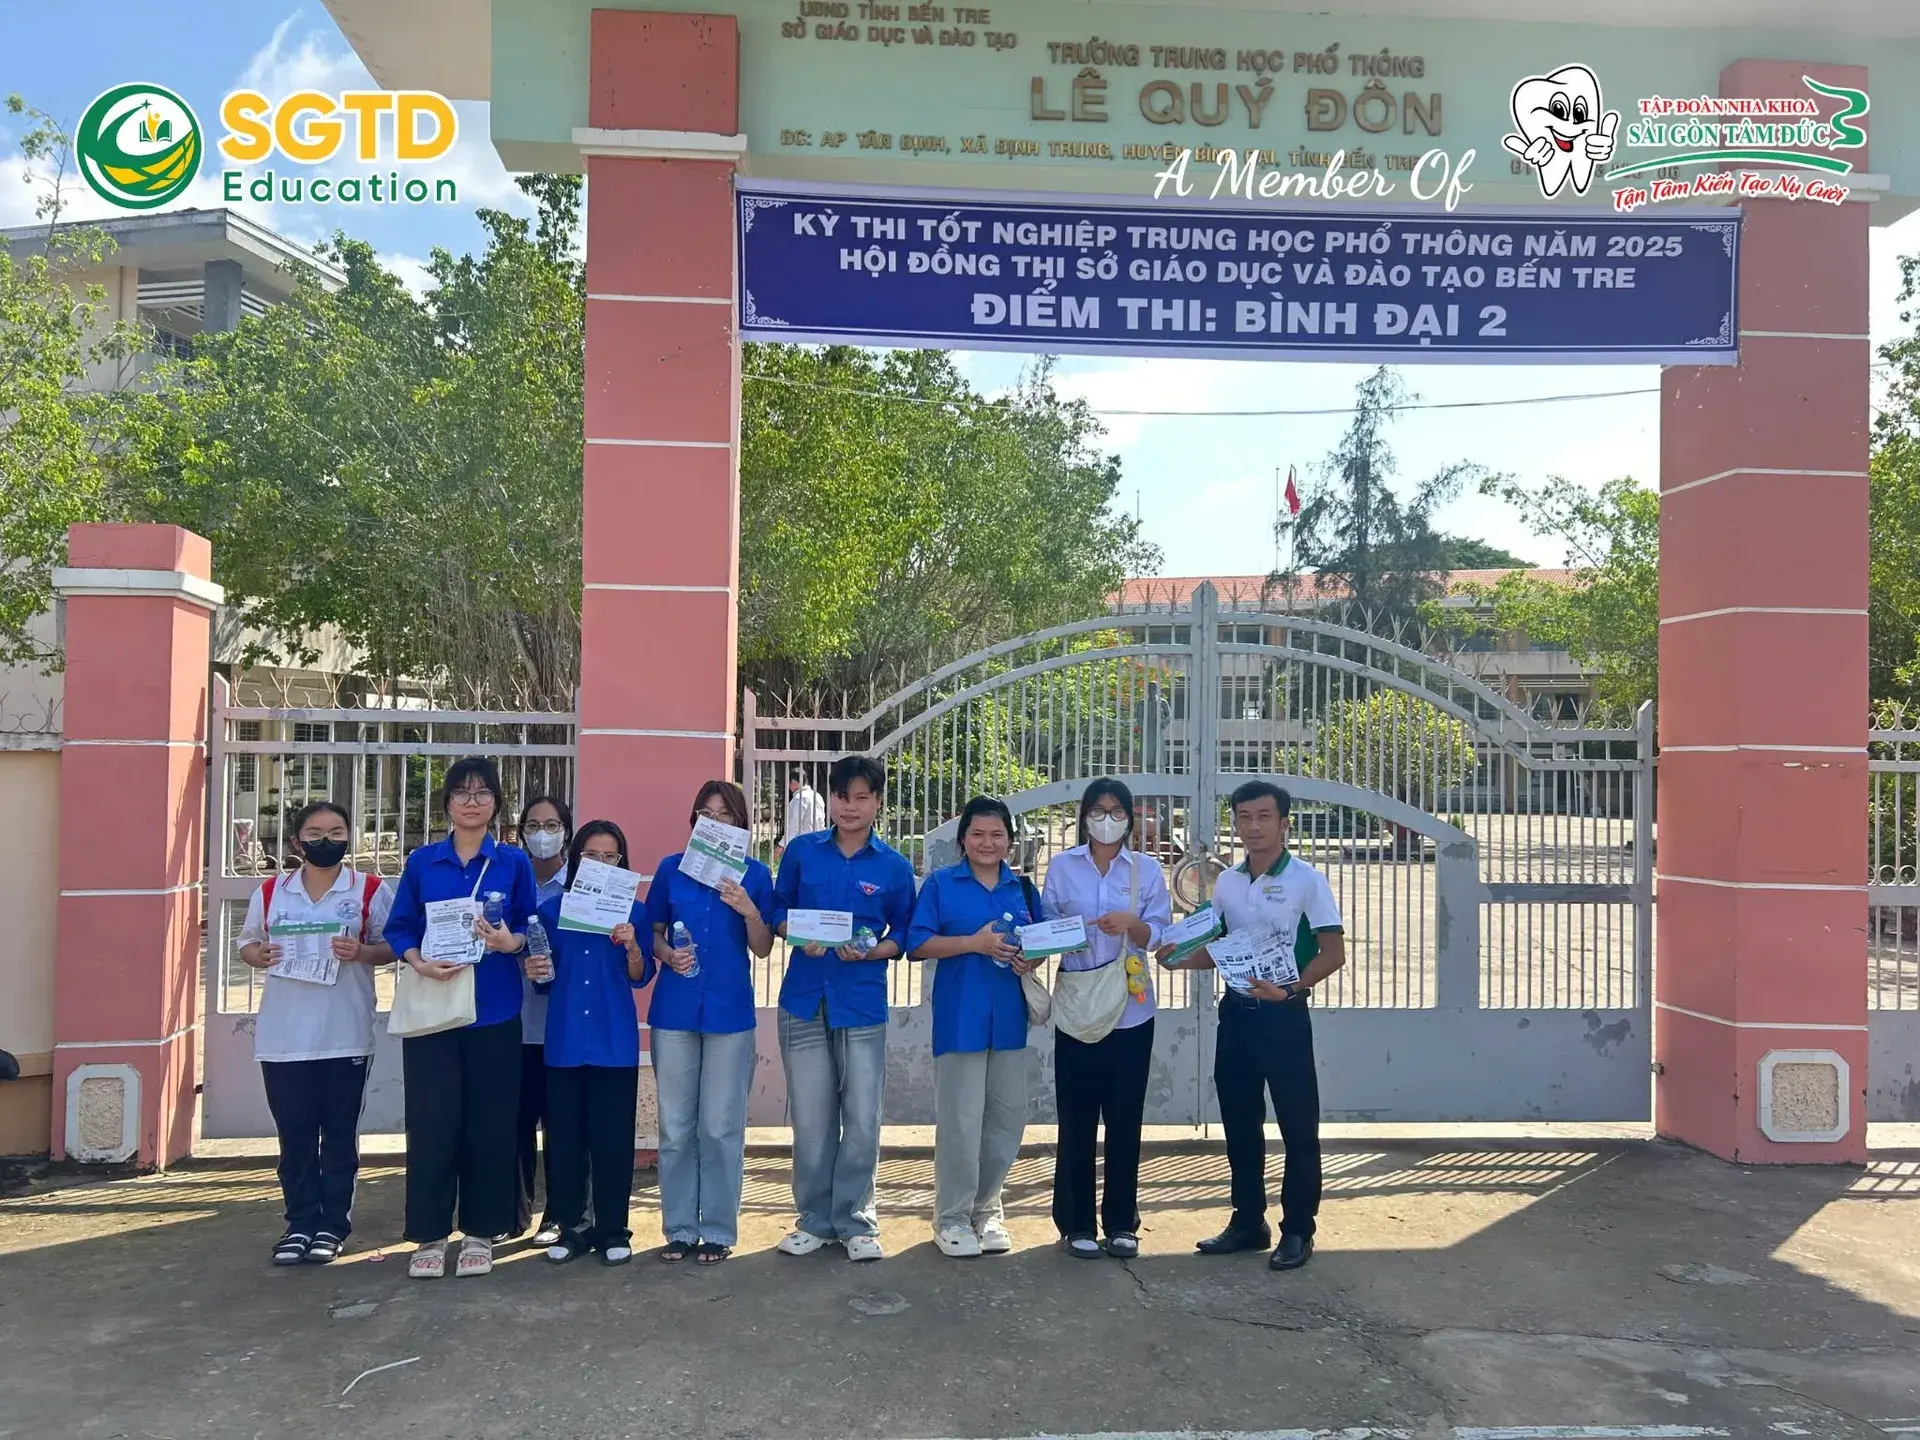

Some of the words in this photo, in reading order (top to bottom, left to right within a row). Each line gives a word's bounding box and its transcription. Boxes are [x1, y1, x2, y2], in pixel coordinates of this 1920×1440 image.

[816, 21, 858, 41] GIÁO
[868, 26, 905, 47] DỤC
[911, 25, 933, 45] VÀ
[939, 28, 975, 48] ĐÀO
[984, 31, 1017, 51] TẠO
[953, 8, 990, 25] TRE
[1150, 45, 1226, 71] TRUNG
[1236, 50, 1284, 76] HỌC
[1349, 48, 1425, 78] THÔNG
[1031, 67, 1108, 122] LÊ
[1139, 77, 1275, 129] QUÝ
[1305, 78, 1442, 136] ĐÔN
[960, 134, 988, 154] XÃ
[1048, 141, 1114, 161] TRUNG,
[794, 208, 840, 237] KỲ
[851, 216, 906, 240] THI
[917, 211, 982, 243] TỐT
[993, 220, 1117, 253] NGHIỆP
[1127, 226, 1237, 251] TRUNG
[1248, 229, 1315, 258] HỌC
[1325, 222, 1392, 254] PHỔ
[1402, 229, 1513, 257] THÔNG
[1524, 230, 1597, 257] NĂM
[1606, 236, 1683, 257] 2025
[840, 245, 896, 278] HỘI
[907, 243, 1000, 276] ĐỒNG
[1011, 255, 1065, 279] THI
[1076, 250, 1118, 280] SỞ
[1129, 254, 1207, 283] GIÁO
[1217, 261, 1283, 289] DỤC
[1293, 258, 1335, 285] VÀ
[1344, 259, 1411, 287] ĐÀO
[1421, 266, 1485, 293] TẠO
[1495, 258, 1561, 288] BẾN
[1573, 267, 1636, 289] TRE
[970, 278, 1100, 329] ĐIỂM
[1117, 298, 1216, 332] THI:
[1235, 292, 1357, 335] BÌNH
[1373, 304, 1460, 345] ĐẠI
[1478, 305, 1507, 337] 2
